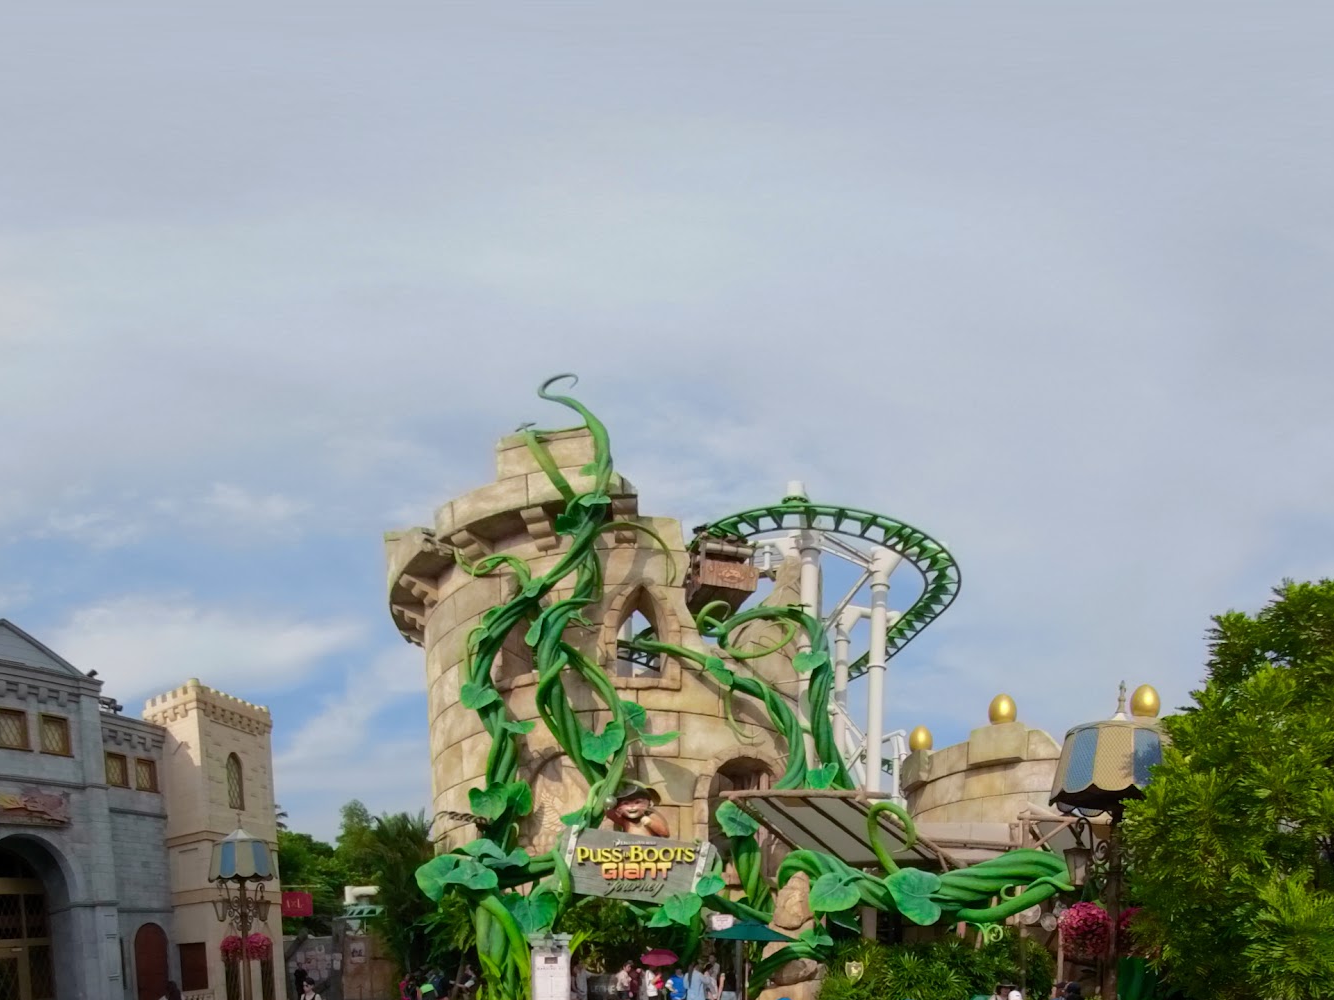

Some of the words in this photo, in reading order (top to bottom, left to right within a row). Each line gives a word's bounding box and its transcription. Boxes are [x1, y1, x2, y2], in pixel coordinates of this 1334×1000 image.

[576, 846, 624, 864] PUSS
[630, 845, 696, 863] BOOTS
[604, 880, 665, 898] Journey
